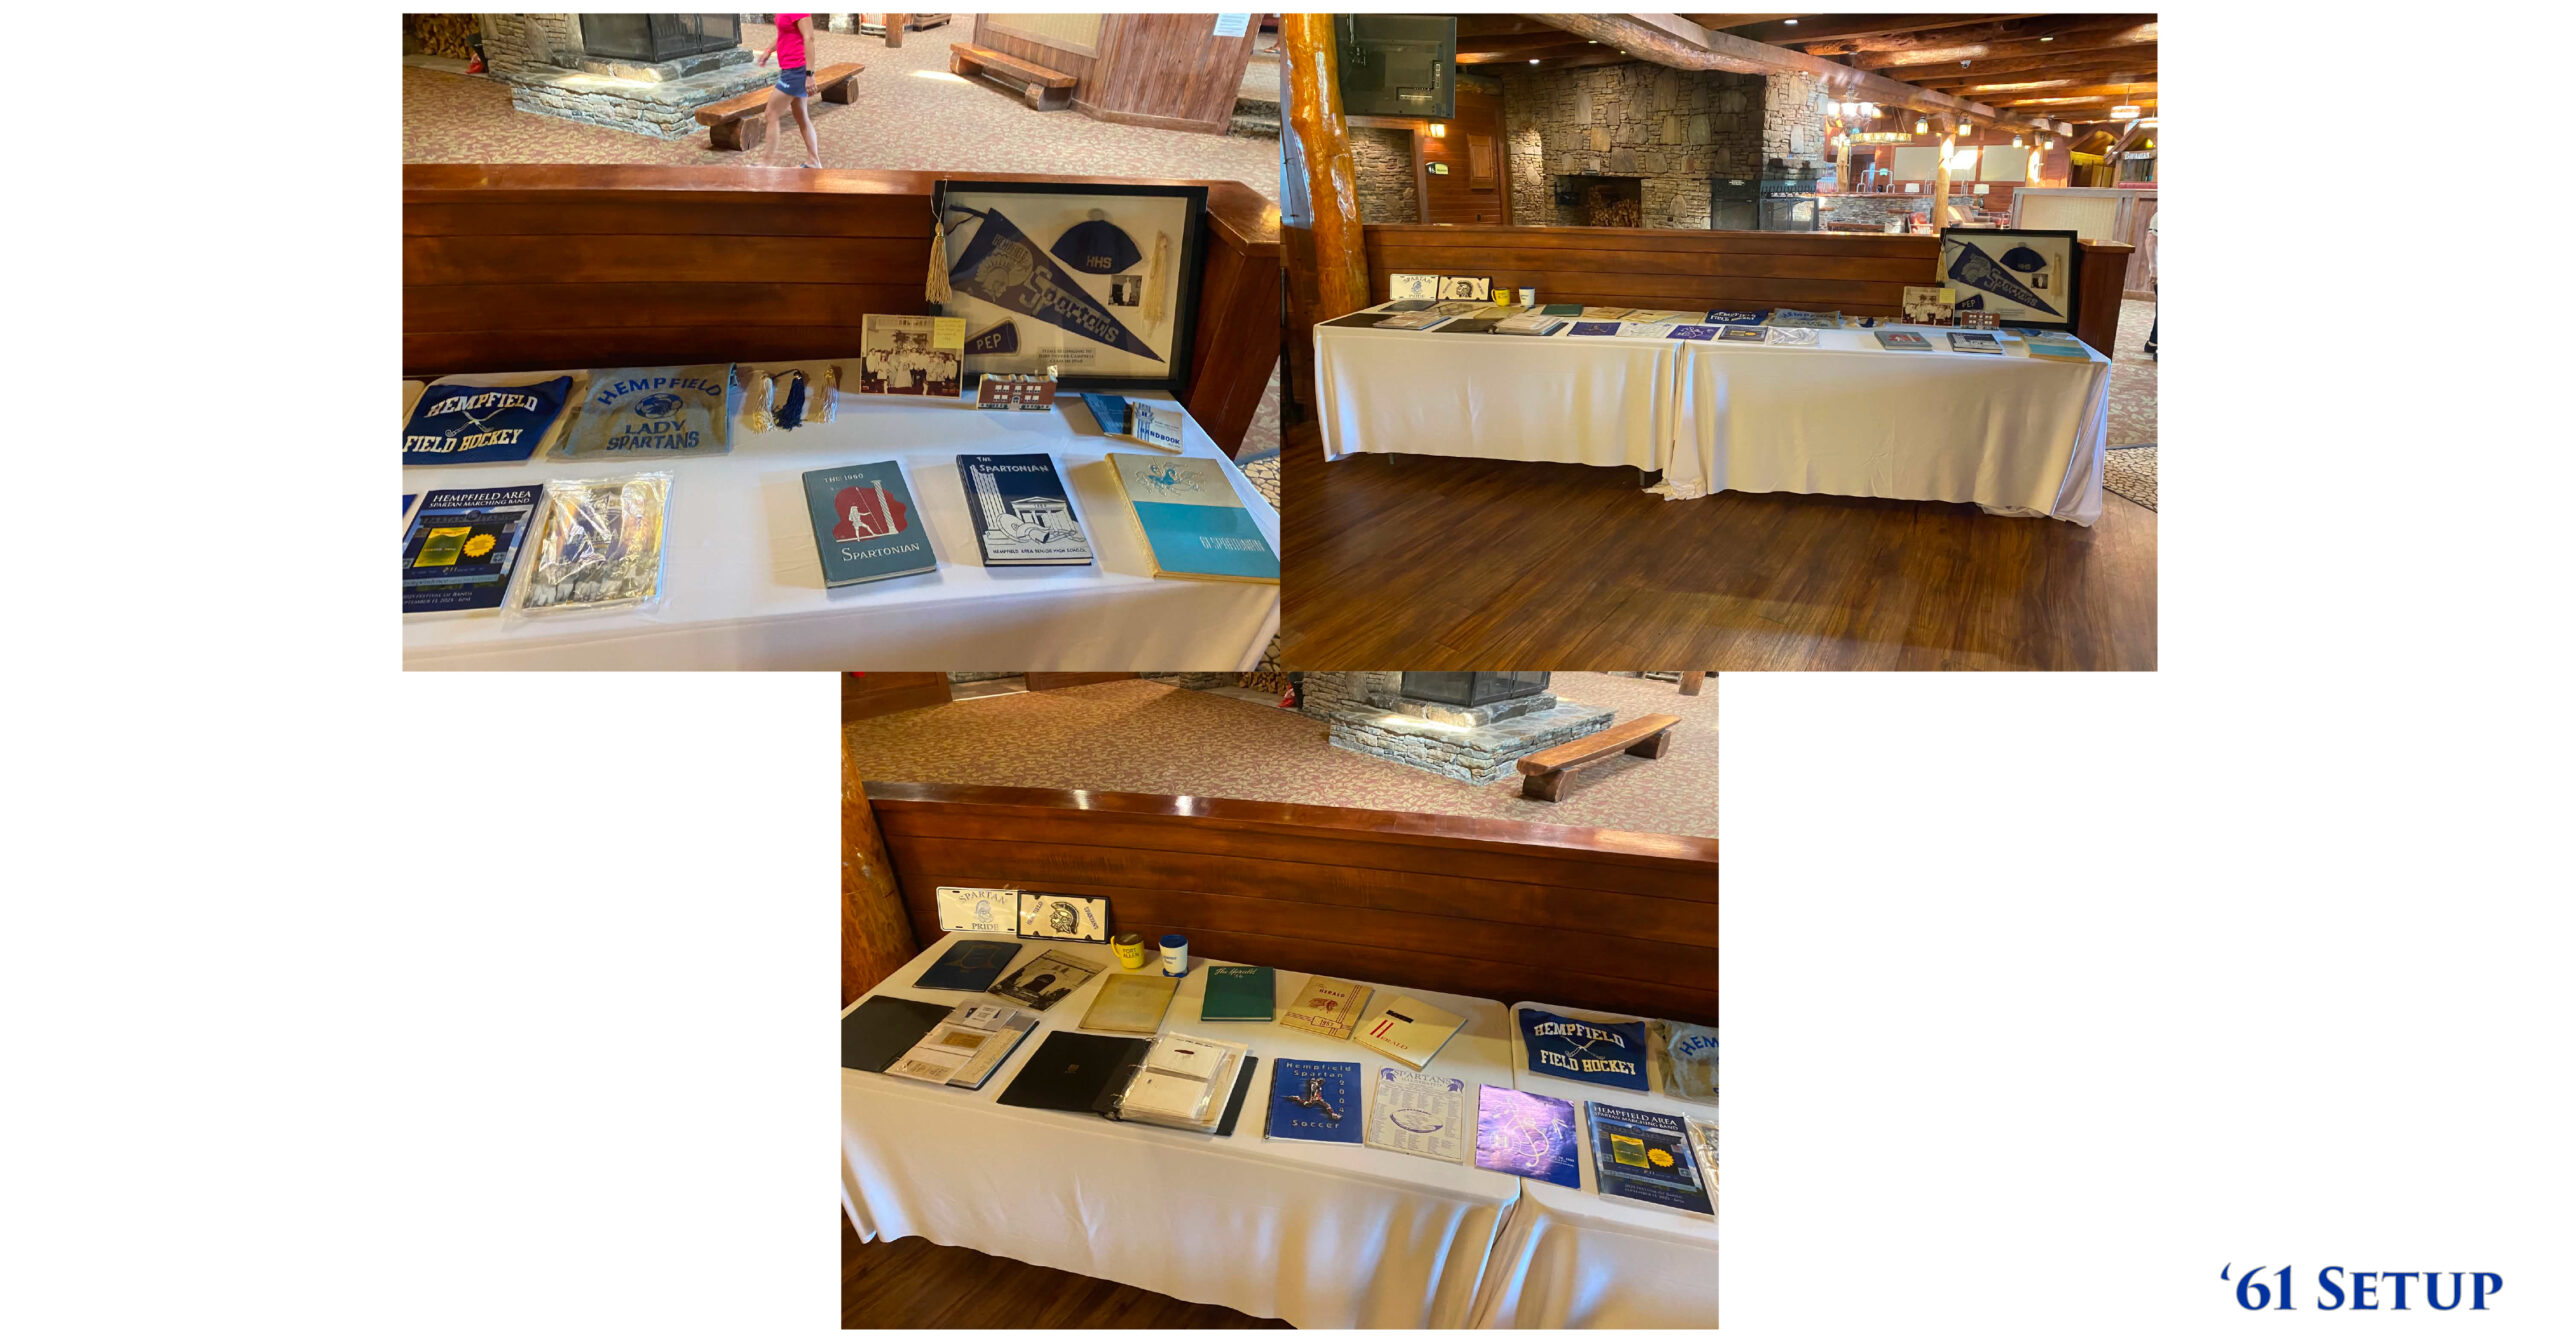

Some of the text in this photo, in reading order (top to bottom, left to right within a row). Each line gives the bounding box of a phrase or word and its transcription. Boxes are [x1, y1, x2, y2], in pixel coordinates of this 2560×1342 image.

[1086, 256, 1113, 268] HHS
[1018, 265, 1120, 342] Spartans
[976, 333, 1002, 350] PEP
[598, 378, 722, 405] HEMPFIELD
[424, 392, 538, 418] HEMPFIELD
[625, 420, 686, 435] LADY
[403, 429, 523, 453] FIELD HOCKEY
[606, 431, 700, 451] SPARTANS
[1140, 428, 1180, 444] HANDBOOK
[980, 464, 1050, 473] SPARTONIAN
[429, 500, 463, 508] SPARTAN
[433, 490, 531, 502] HEMPFIELD AREA
[841, 542, 920, 562] SPARTONIAN
[1319, 988, 1346, 998] HERALD
[1534, 1022, 1625, 1048] HEMPFIELD
[1286, 1062, 1351, 1072] Hempfield
[1540, 1050, 1636, 1075] FIELD HOCKEY
[1293, 1070, 1343, 1078] Spartan
[1394, 1069, 1451, 1085] SPARTANS
[1292, 1120, 1340, 1128] Soccer
[1594, 1106, 1677, 1126] HEMPFIELD AREA
[1594, 1111, 1621, 1120] SPARTAN
[1621, 1116, 1658, 1128] MARCHING
